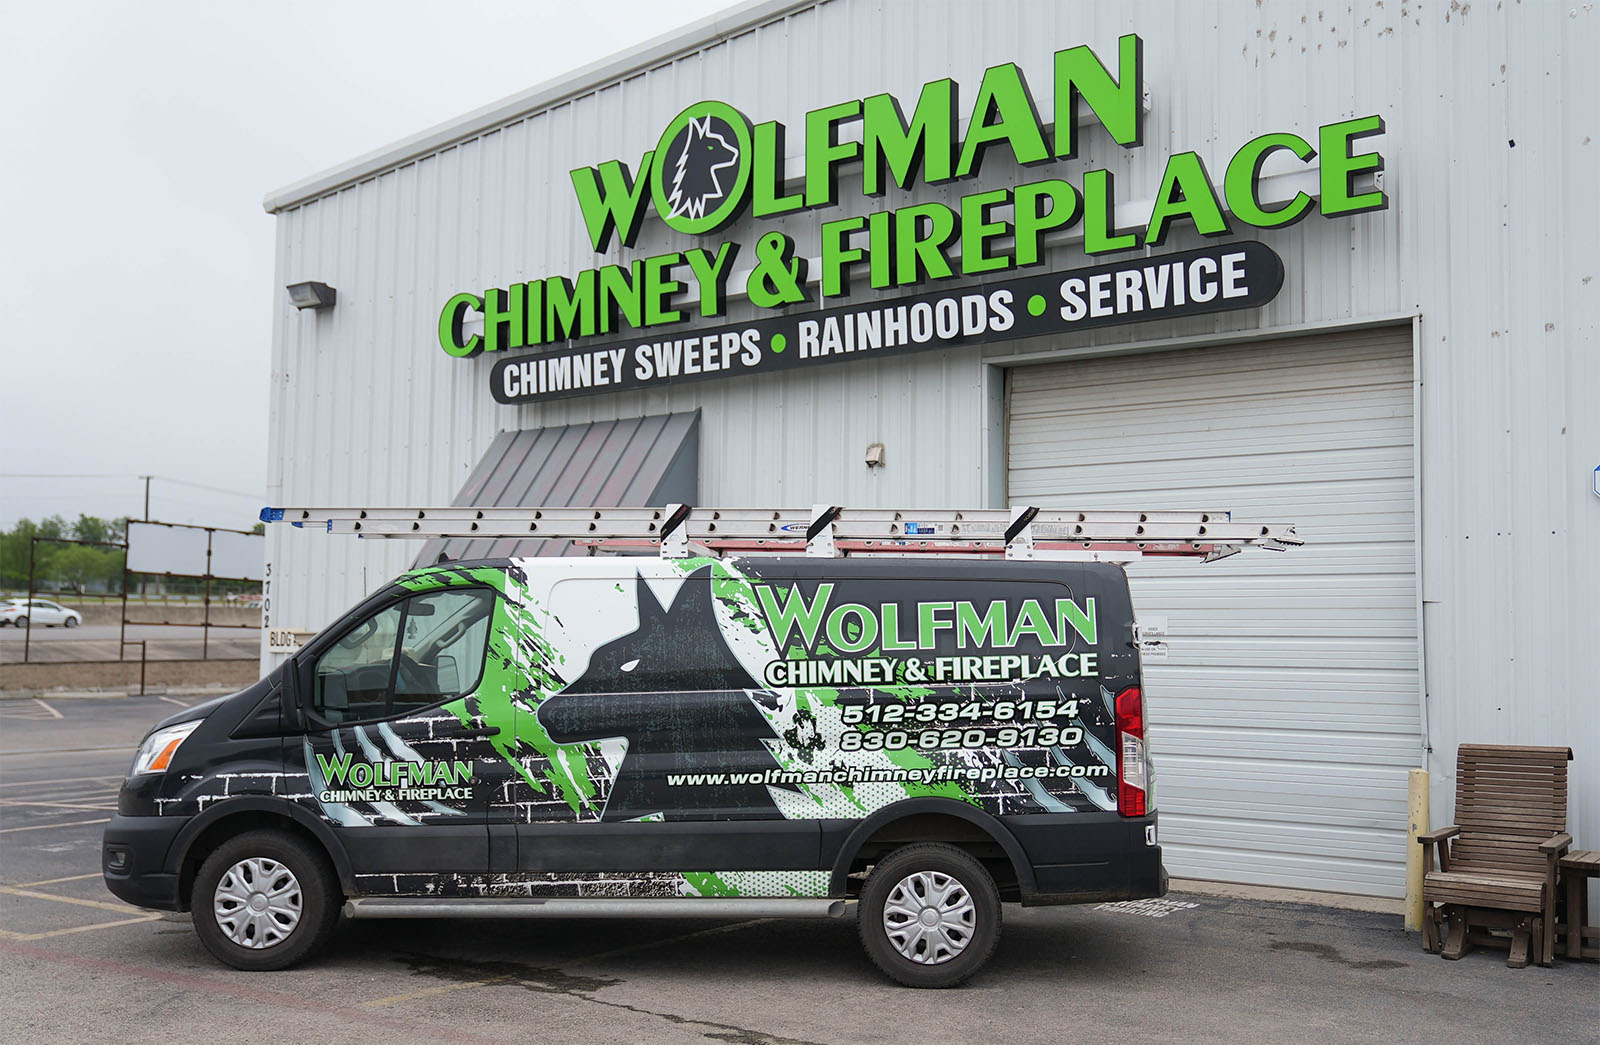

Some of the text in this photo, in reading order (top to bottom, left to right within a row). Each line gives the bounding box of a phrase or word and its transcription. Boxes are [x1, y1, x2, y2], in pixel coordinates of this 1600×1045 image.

[570, 33, 1141, 253] WOLFMAN
[439, 115, 1386, 357] CHIMNEY & FIREPLACE
[503, 252, 1248, 397] CHIMNEY SWEEPS RAINHOODS SERVICE
[264, 563, 272, 628] 3702
[755, 582, 1097, 652] WOLFMAN
[270, 631, 291, 647] BLDG
[764, 653, 1099, 686] CHIMNEY & FIREPLACE
[842, 700, 1080, 724] 512-334-6154
[840, 727, 1084, 751] 830-620-9130
[316, 753, 474, 787] WOLFMAN
[667, 764, 1109, 787] www.wolfmanchimneyfireplace.com
[320, 787, 474, 802] CHIMNEY & FIREPLACE
